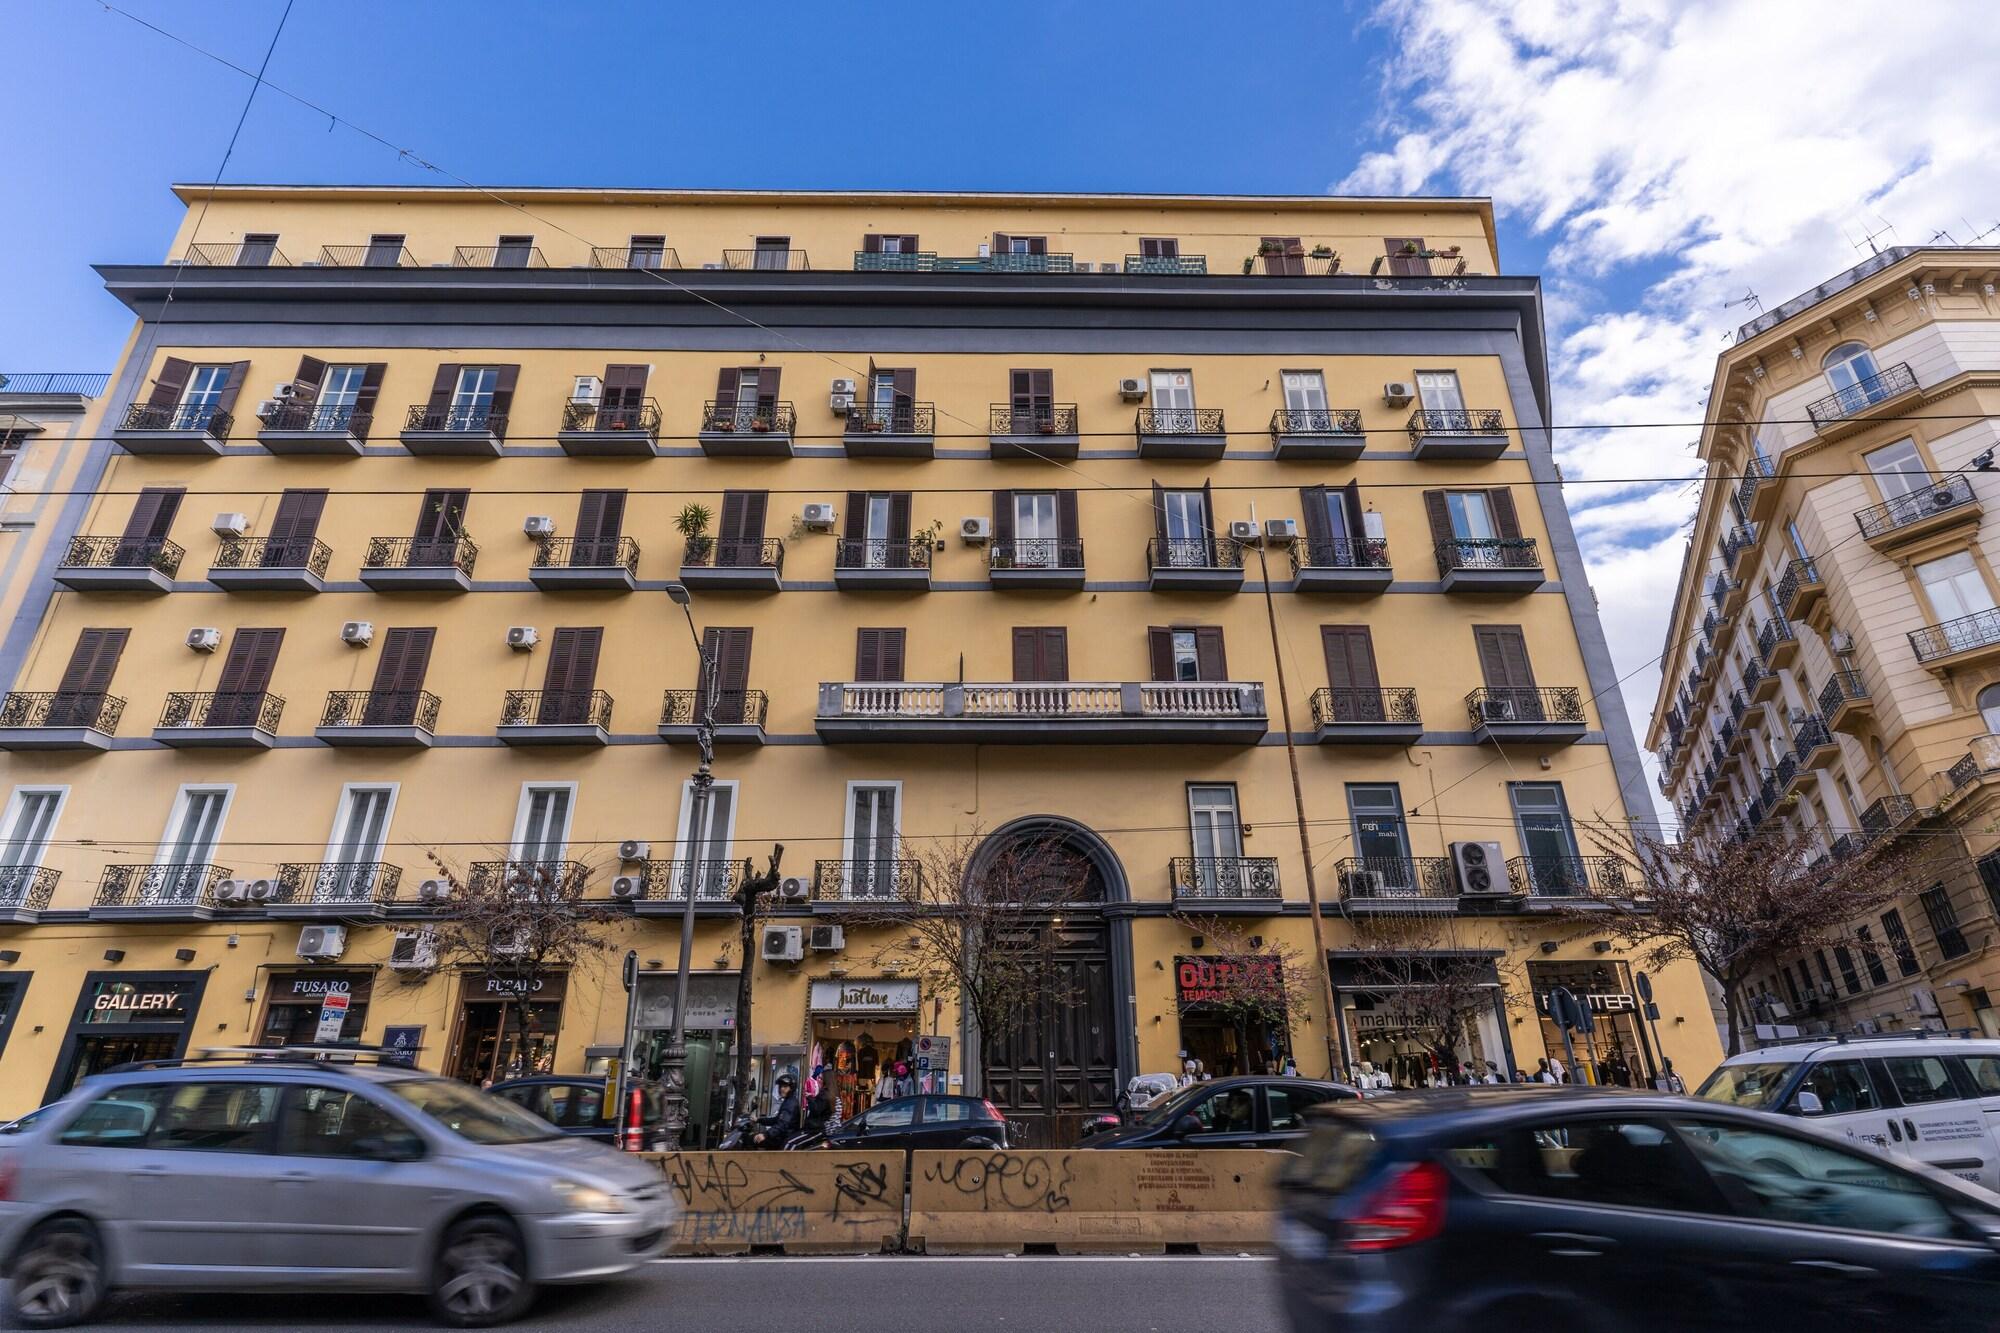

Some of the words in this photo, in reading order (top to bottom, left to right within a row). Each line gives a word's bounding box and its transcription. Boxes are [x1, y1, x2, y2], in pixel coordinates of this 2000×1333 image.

[293, 981, 349, 993] FUSARO
[94, 994, 178, 1010] GALLERY
[322, 1010, 330, 1020] P
[920, 1057, 928, 1068] P
